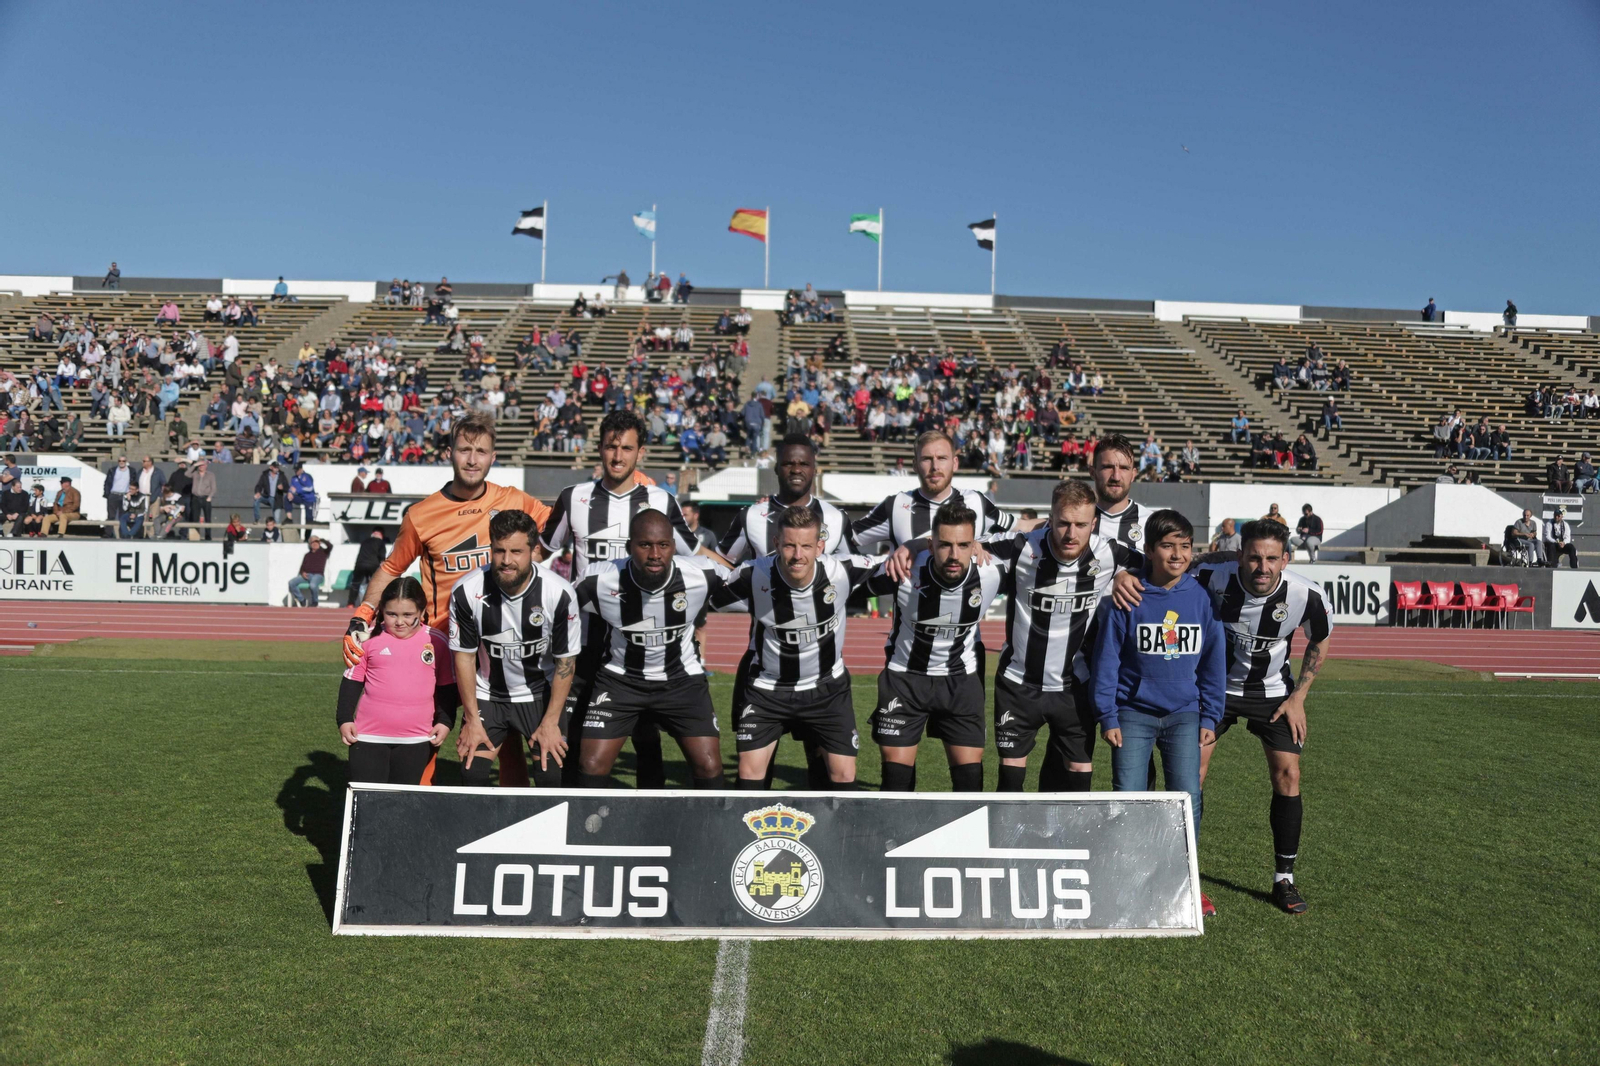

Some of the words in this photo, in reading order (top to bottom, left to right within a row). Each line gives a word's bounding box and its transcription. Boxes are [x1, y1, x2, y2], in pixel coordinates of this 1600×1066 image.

[457, 508, 483, 516] LEGEA
[584, 540, 627, 560] LOT
[116, 551, 140, 583] El
[151, 552, 250, 593] Monje
[443, 551, 492, 573] LOT
[0, 579, 73, 591] URANTE
[130, 585, 201, 596] FERRETERÍA
[1314, 574, 1380, 616] AÑOS
[1027, 593, 1099, 613] LOTUS
[911, 621, 973, 639] LOTU
[1226, 629, 1280, 653] OTUS
[490, 636, 549, 660] OTUS
[735, 859, 749, 887] REAL
[754, 839, 820, 888] BALOMPEDICA
[453, 862, 669, 918] LOTUS
[885, 867, 1092, 919] LOTUS
[751, 902, 804, 919] LINENSE
